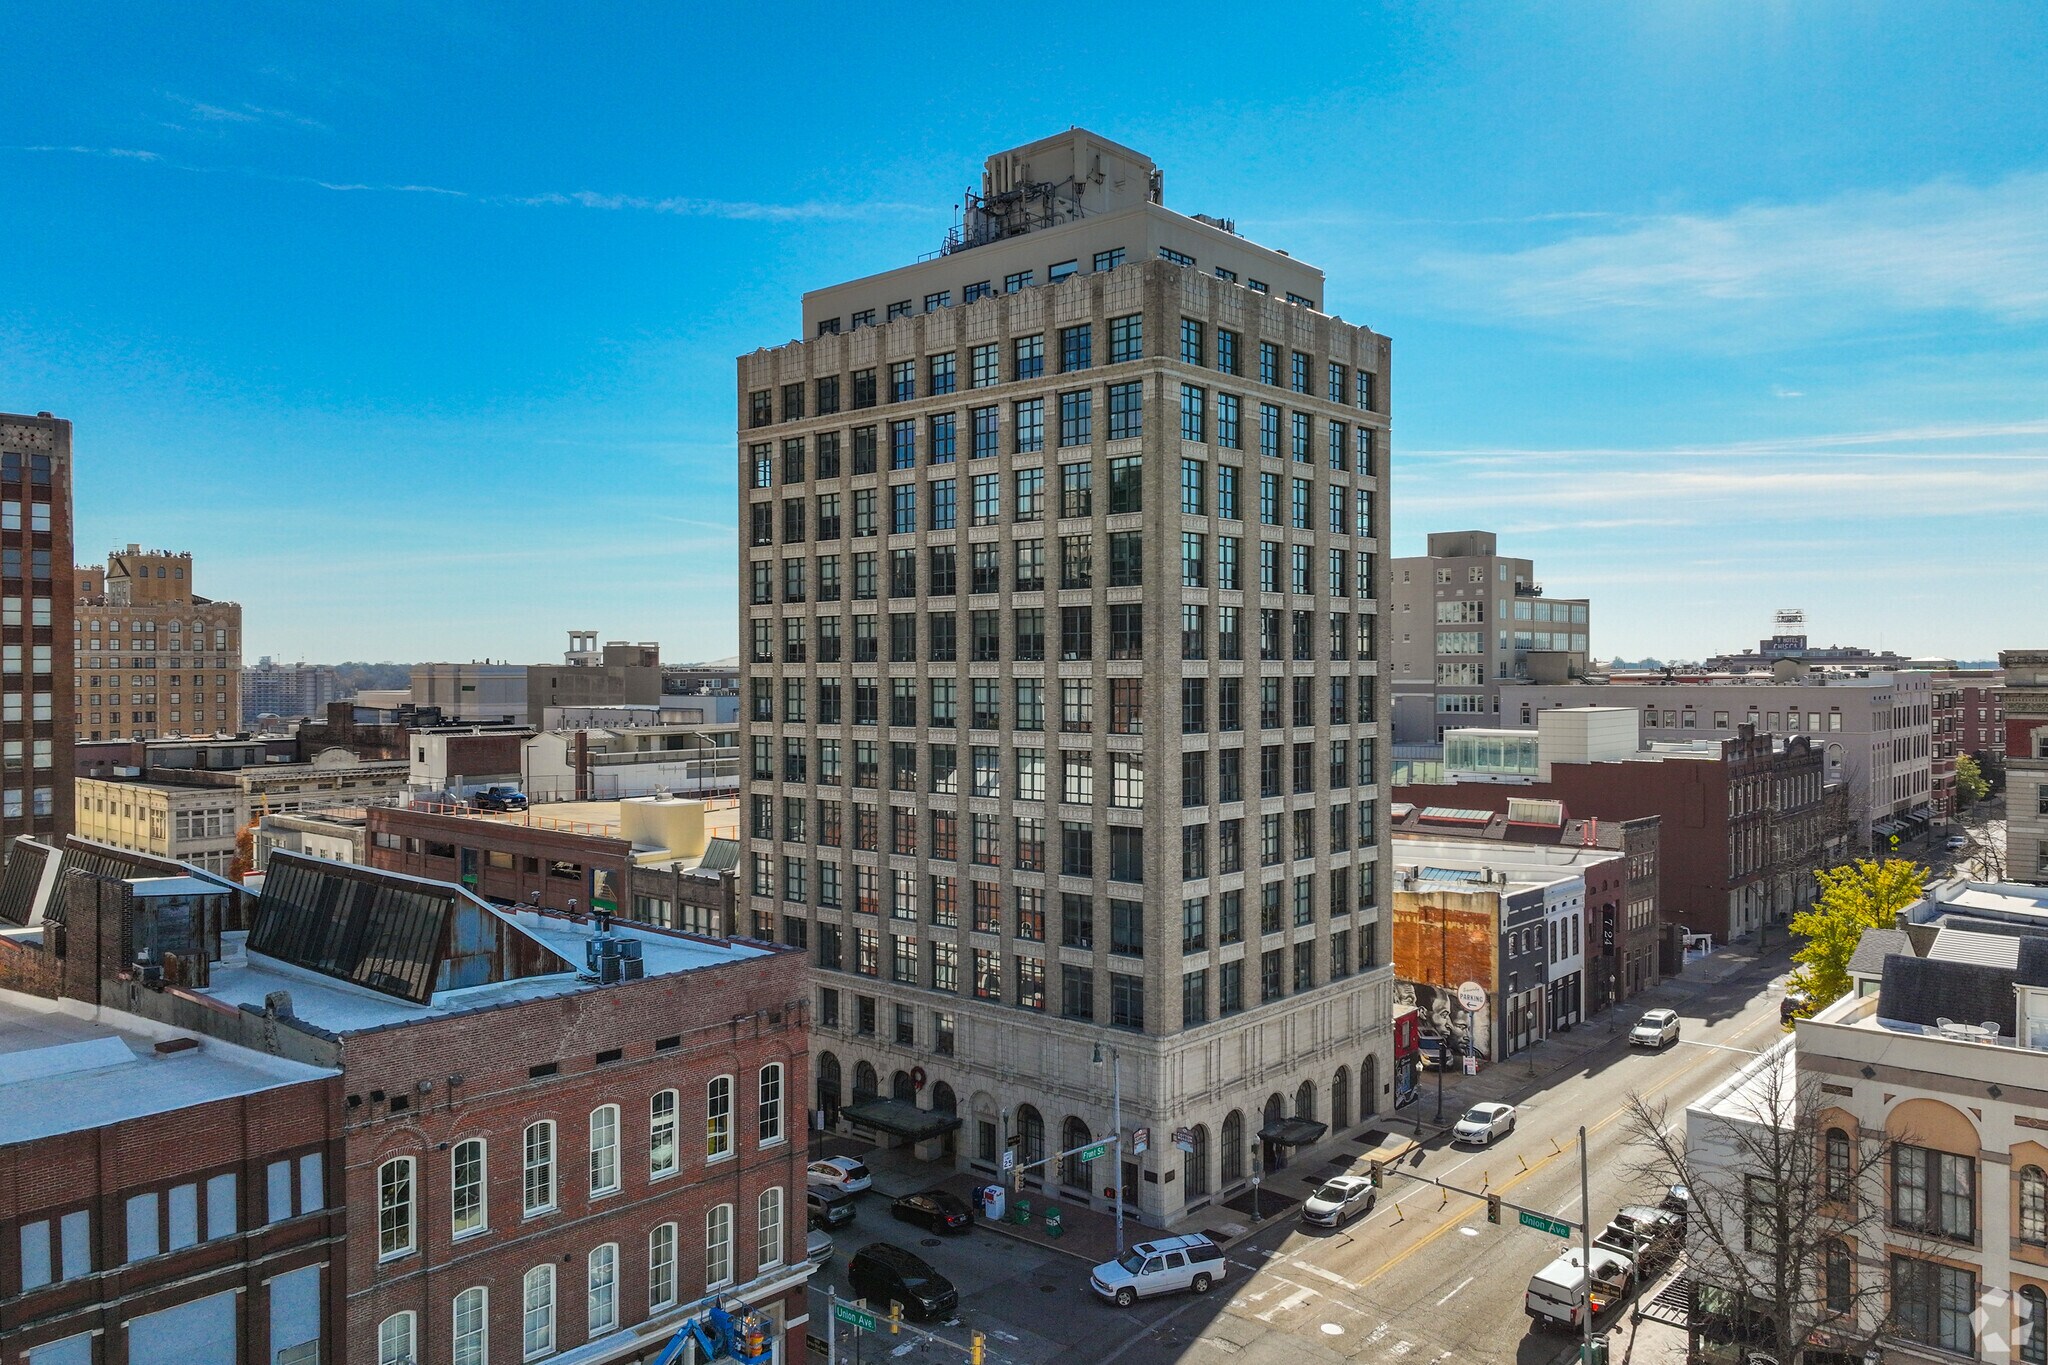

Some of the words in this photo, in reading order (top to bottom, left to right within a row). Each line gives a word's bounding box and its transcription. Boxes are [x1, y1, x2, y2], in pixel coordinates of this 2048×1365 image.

[1460, 993, 1484, 1003] PARKING
[1082, 1149, 1097, 1160] Front
[1003, 1160, 1013, 1168] 25
[1521, 1214, 1545, 1229] Union
[1549, 1222, 1568, 1236] Ave.
[836, 1307, 856, 1322] Union
[858, 1315, 874, 1329] Ave.
